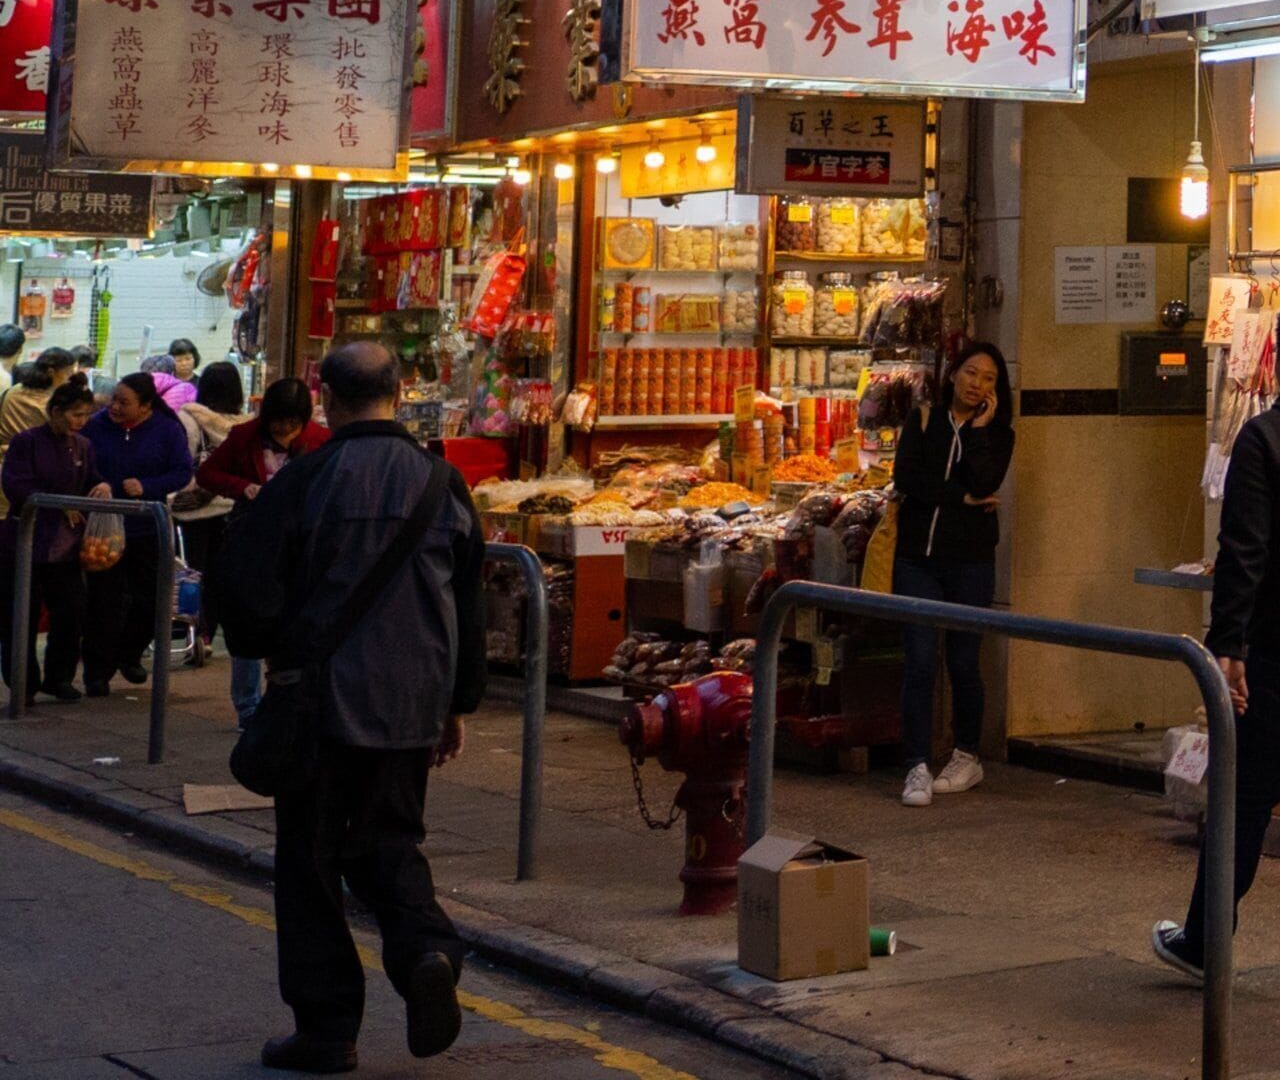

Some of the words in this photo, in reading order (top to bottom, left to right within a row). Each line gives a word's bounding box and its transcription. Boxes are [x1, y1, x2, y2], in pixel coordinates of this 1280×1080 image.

[108, 26, 144, 141] 燕窩蟲草
[258, 32, 294, 145] 環球海味
[332, 36, 367, 148] 批發零售
[789, 108, 895, 138] 百草之王
[35, 191, 133, 215] 優質果菜
